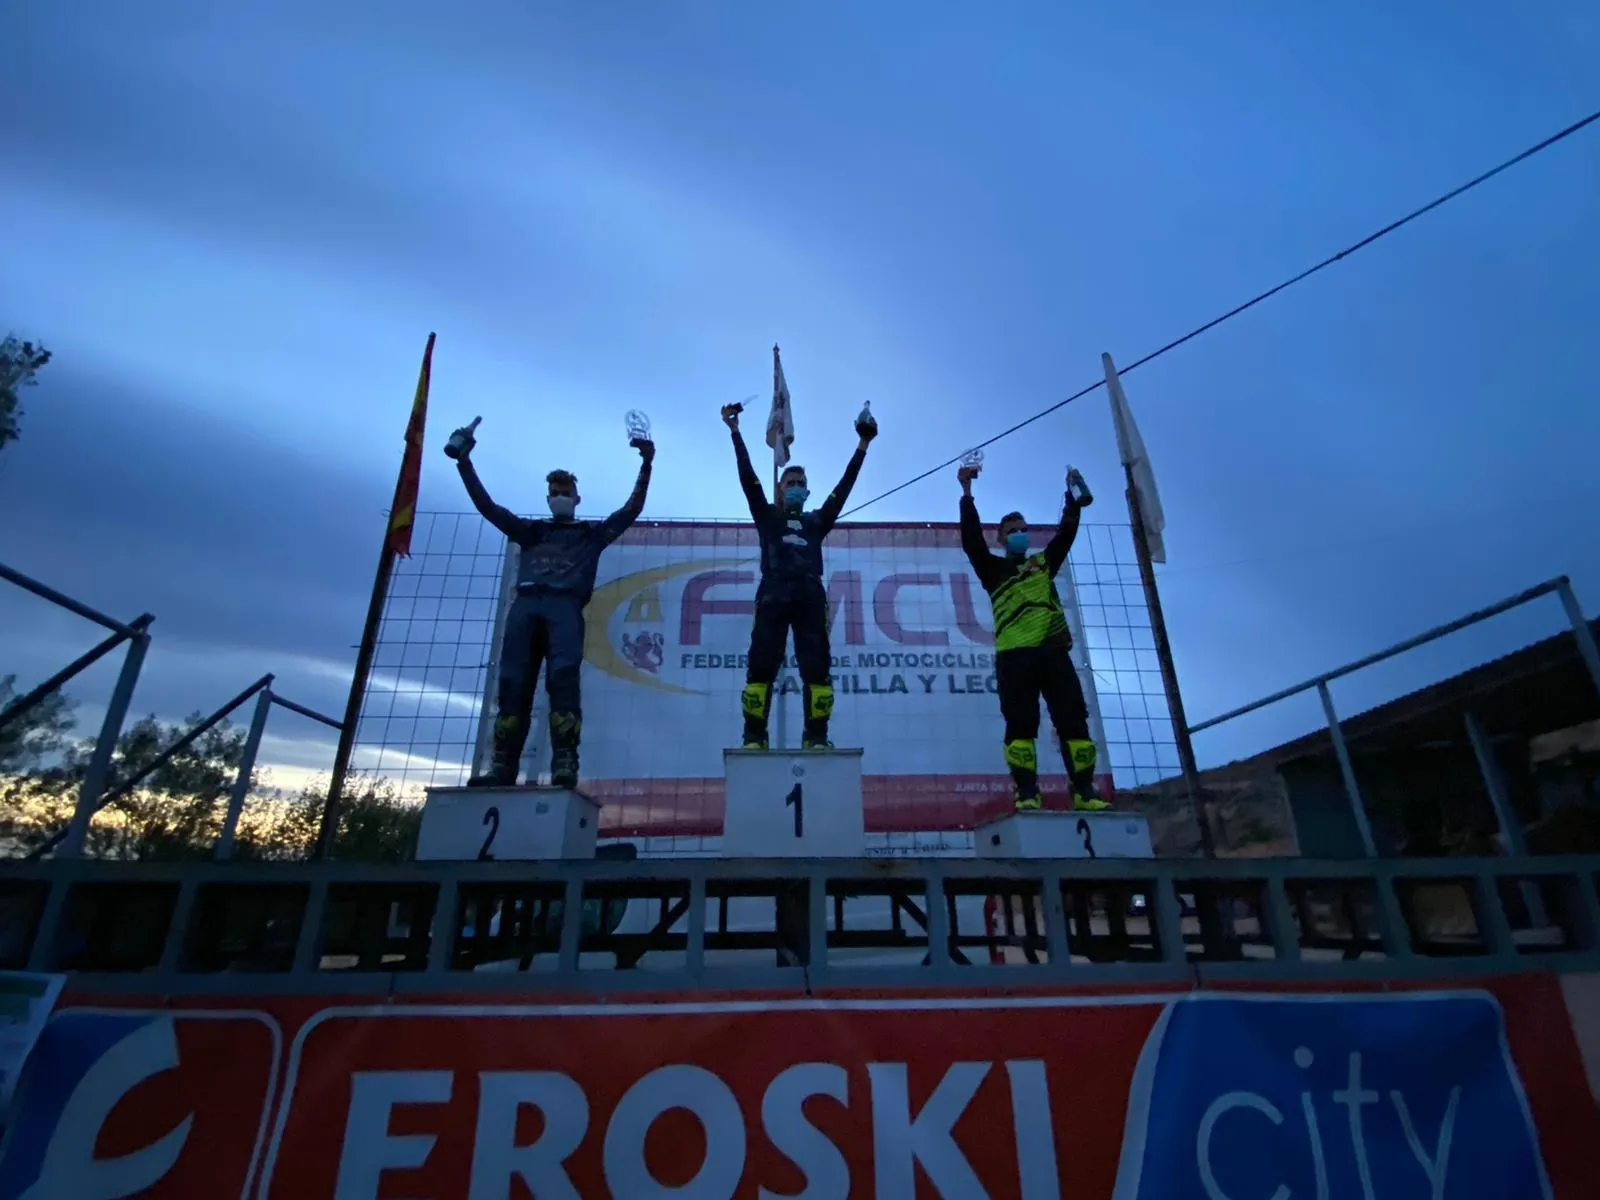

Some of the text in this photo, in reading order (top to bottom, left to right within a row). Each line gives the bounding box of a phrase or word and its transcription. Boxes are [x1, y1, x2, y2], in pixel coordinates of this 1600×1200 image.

[829, 655, 851, 668] DE
[858, 652, 998, 669] MOTOCICLIS
[917, 674, 937, 694] Y
[948, 674, 999, 694] LEO
[477, 807, 500, 861] 2
[786, 783, 803, 837] 1
[333, 1045, 1463, 1200] EROSKI city
